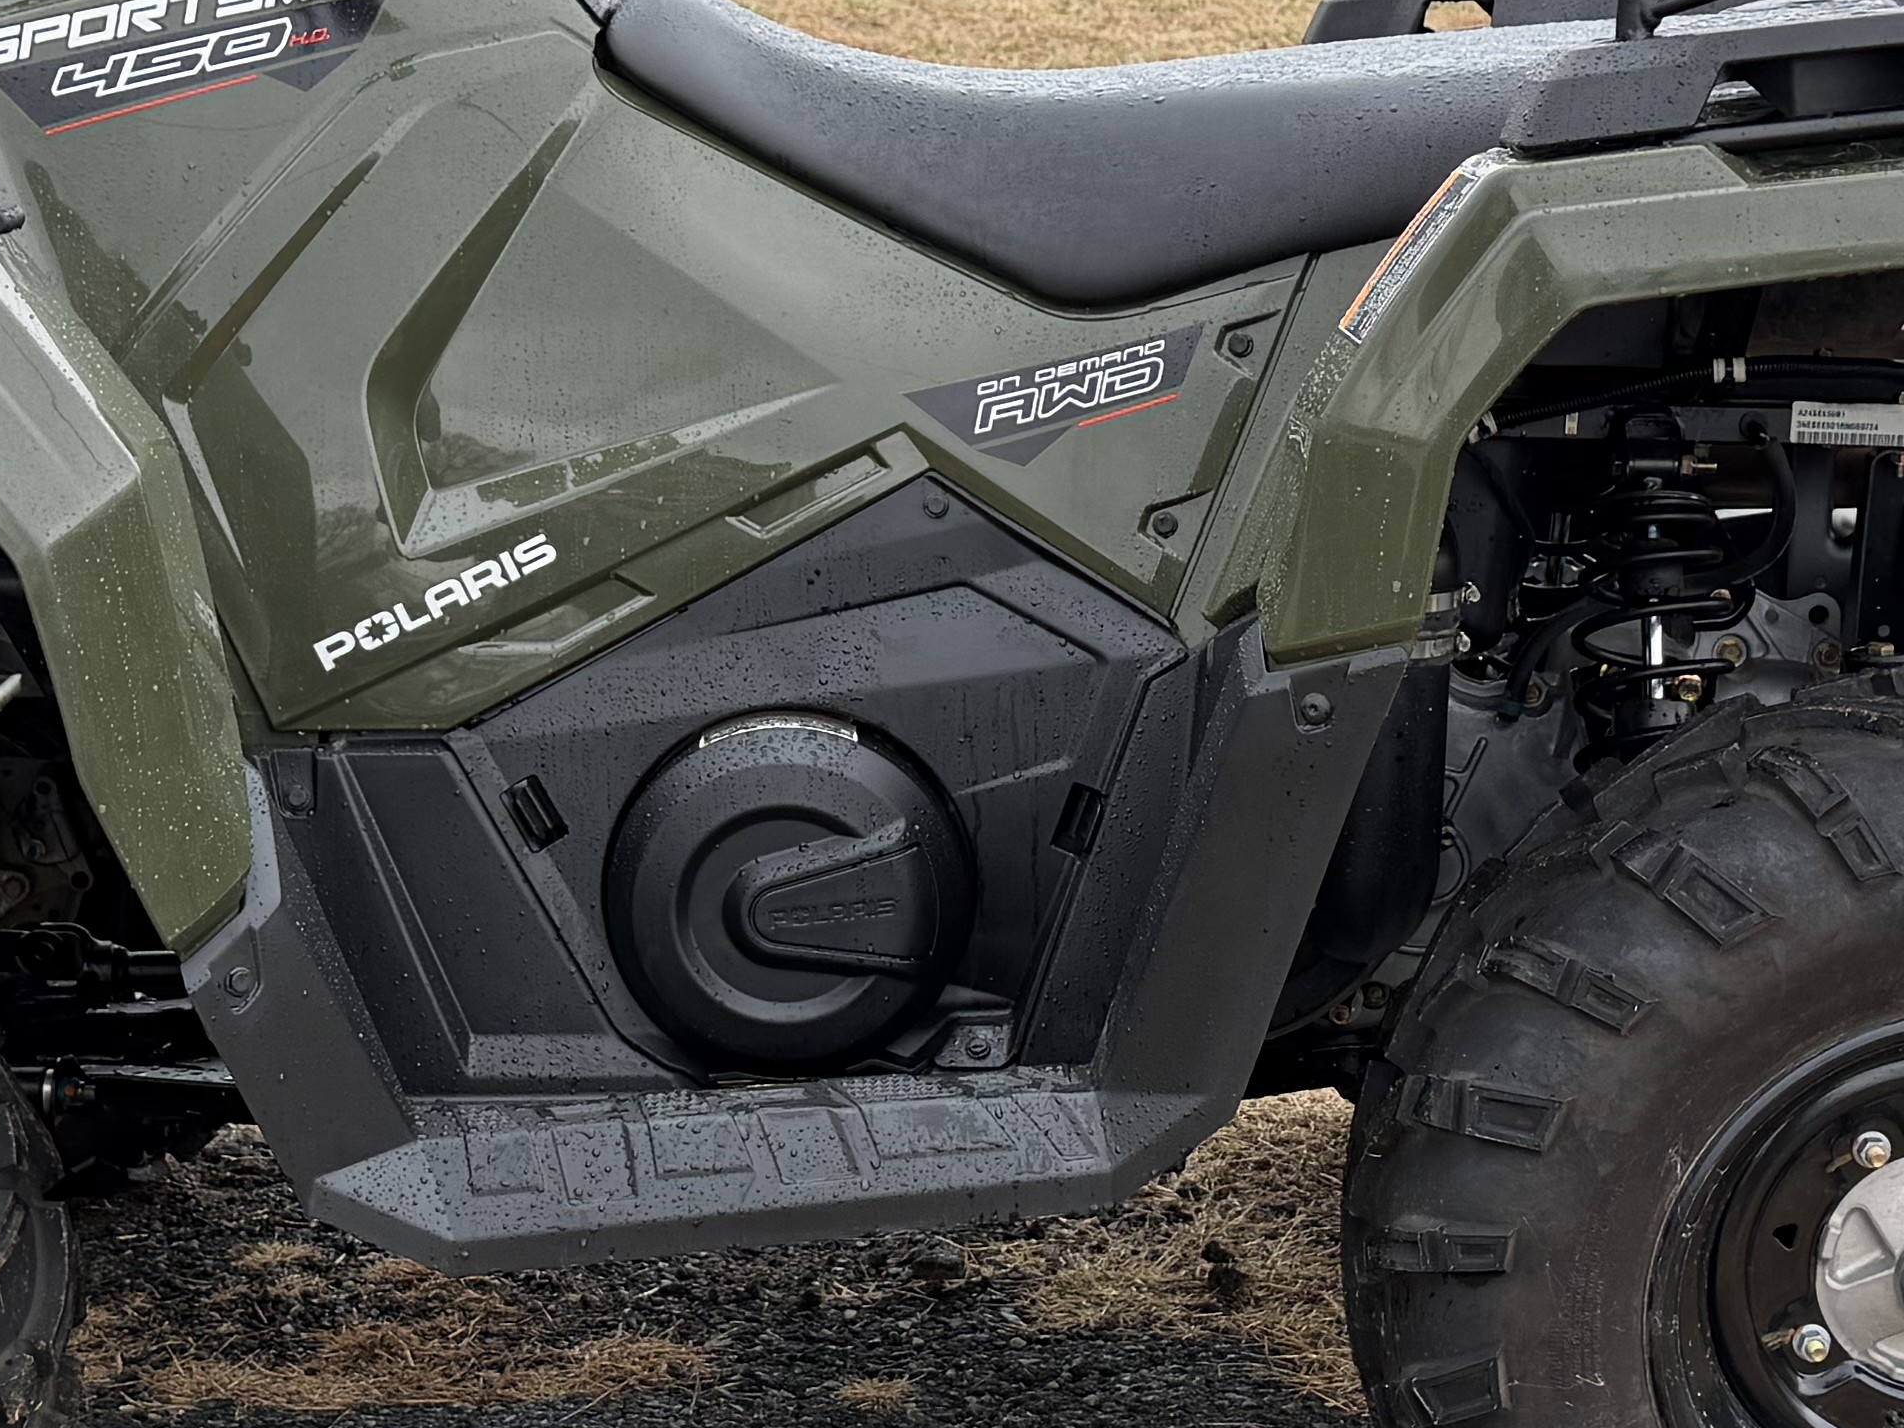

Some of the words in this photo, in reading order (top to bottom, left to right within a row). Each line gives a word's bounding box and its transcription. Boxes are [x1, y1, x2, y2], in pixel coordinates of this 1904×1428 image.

[50, 16, 295, 99] 450
[973, 356, 1165, 435] AWD
[976, 375, 1021, 396] ON
[1034, 339, 1166, 381] DEMAND
[312, 532, 558, 673] POLARIS
[768, 896, 902, 932] POLARIS
